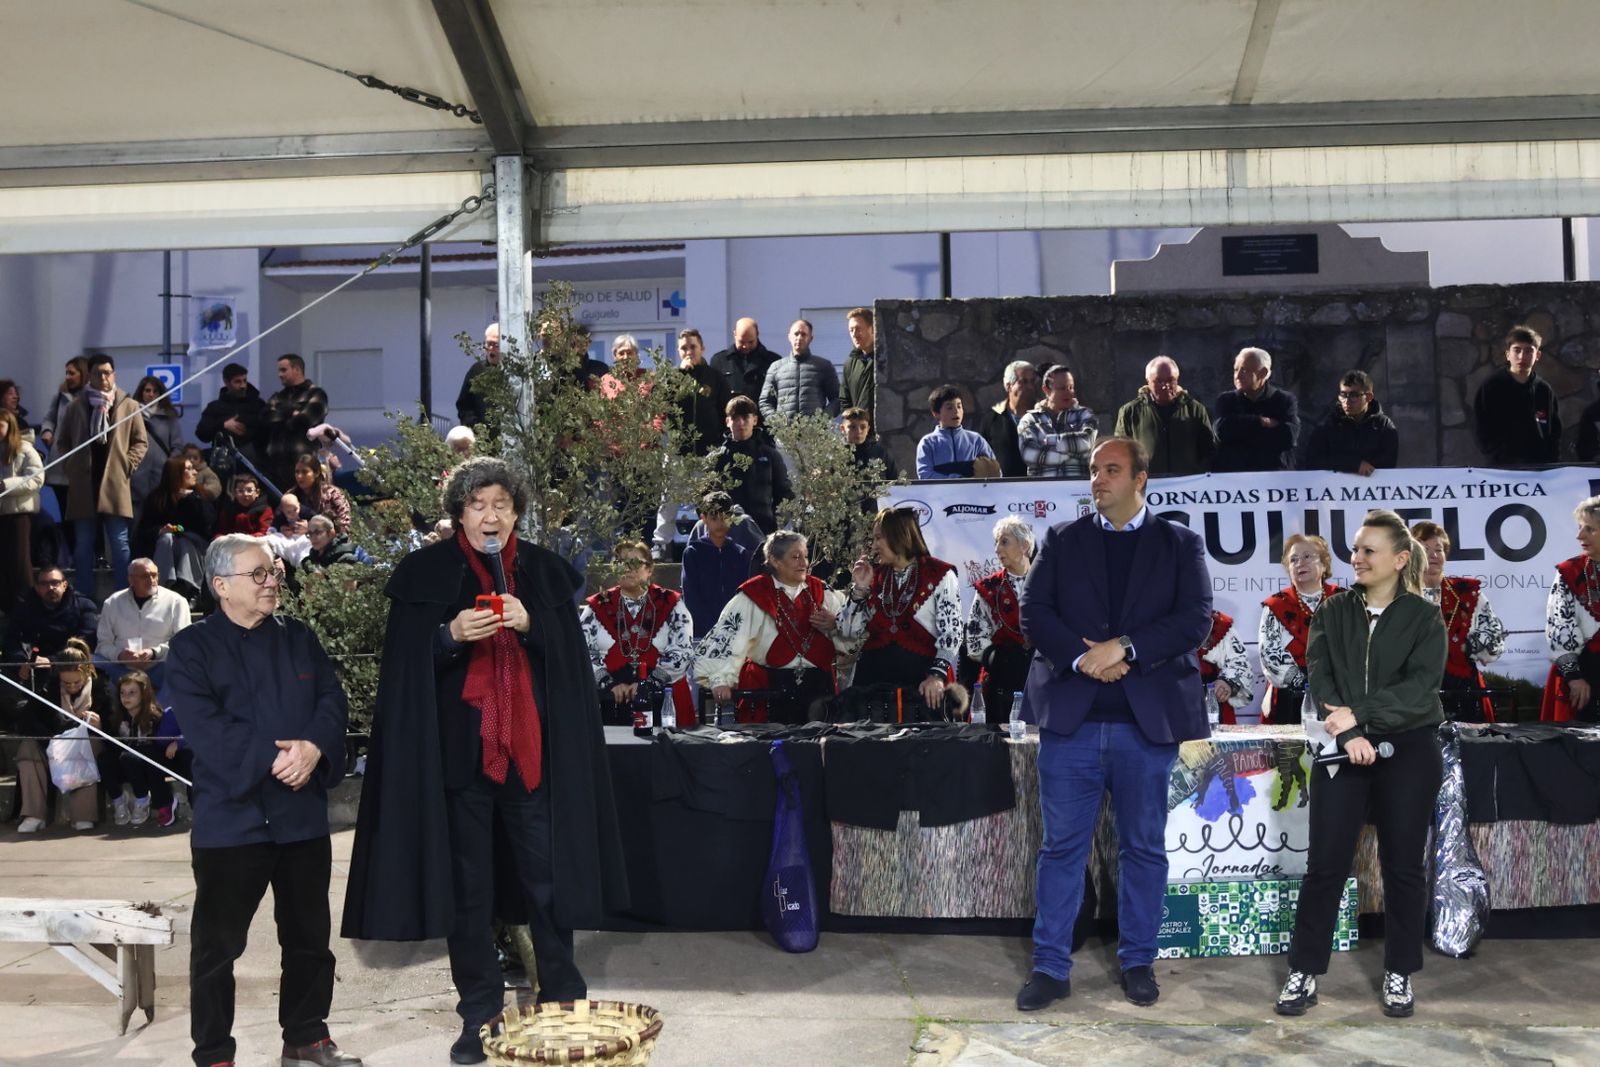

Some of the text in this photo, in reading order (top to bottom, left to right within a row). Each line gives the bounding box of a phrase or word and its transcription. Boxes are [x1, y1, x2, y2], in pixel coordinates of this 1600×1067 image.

[598, 291, 613, 303] DE
[616, 290, 652, 302] SALUD
[1146, 480, 1548, 507] ORNADAS DE LA MATANZA TÍPICA
[952, 505, 988, 513] ALJOMAR
[1007, 500, 1057, 518] crego
[1213, 577, 1236, 592] DE
[1449, 573, 1551, 589] GIONAL
[1160, 920, 1183, 928] ASTRO
